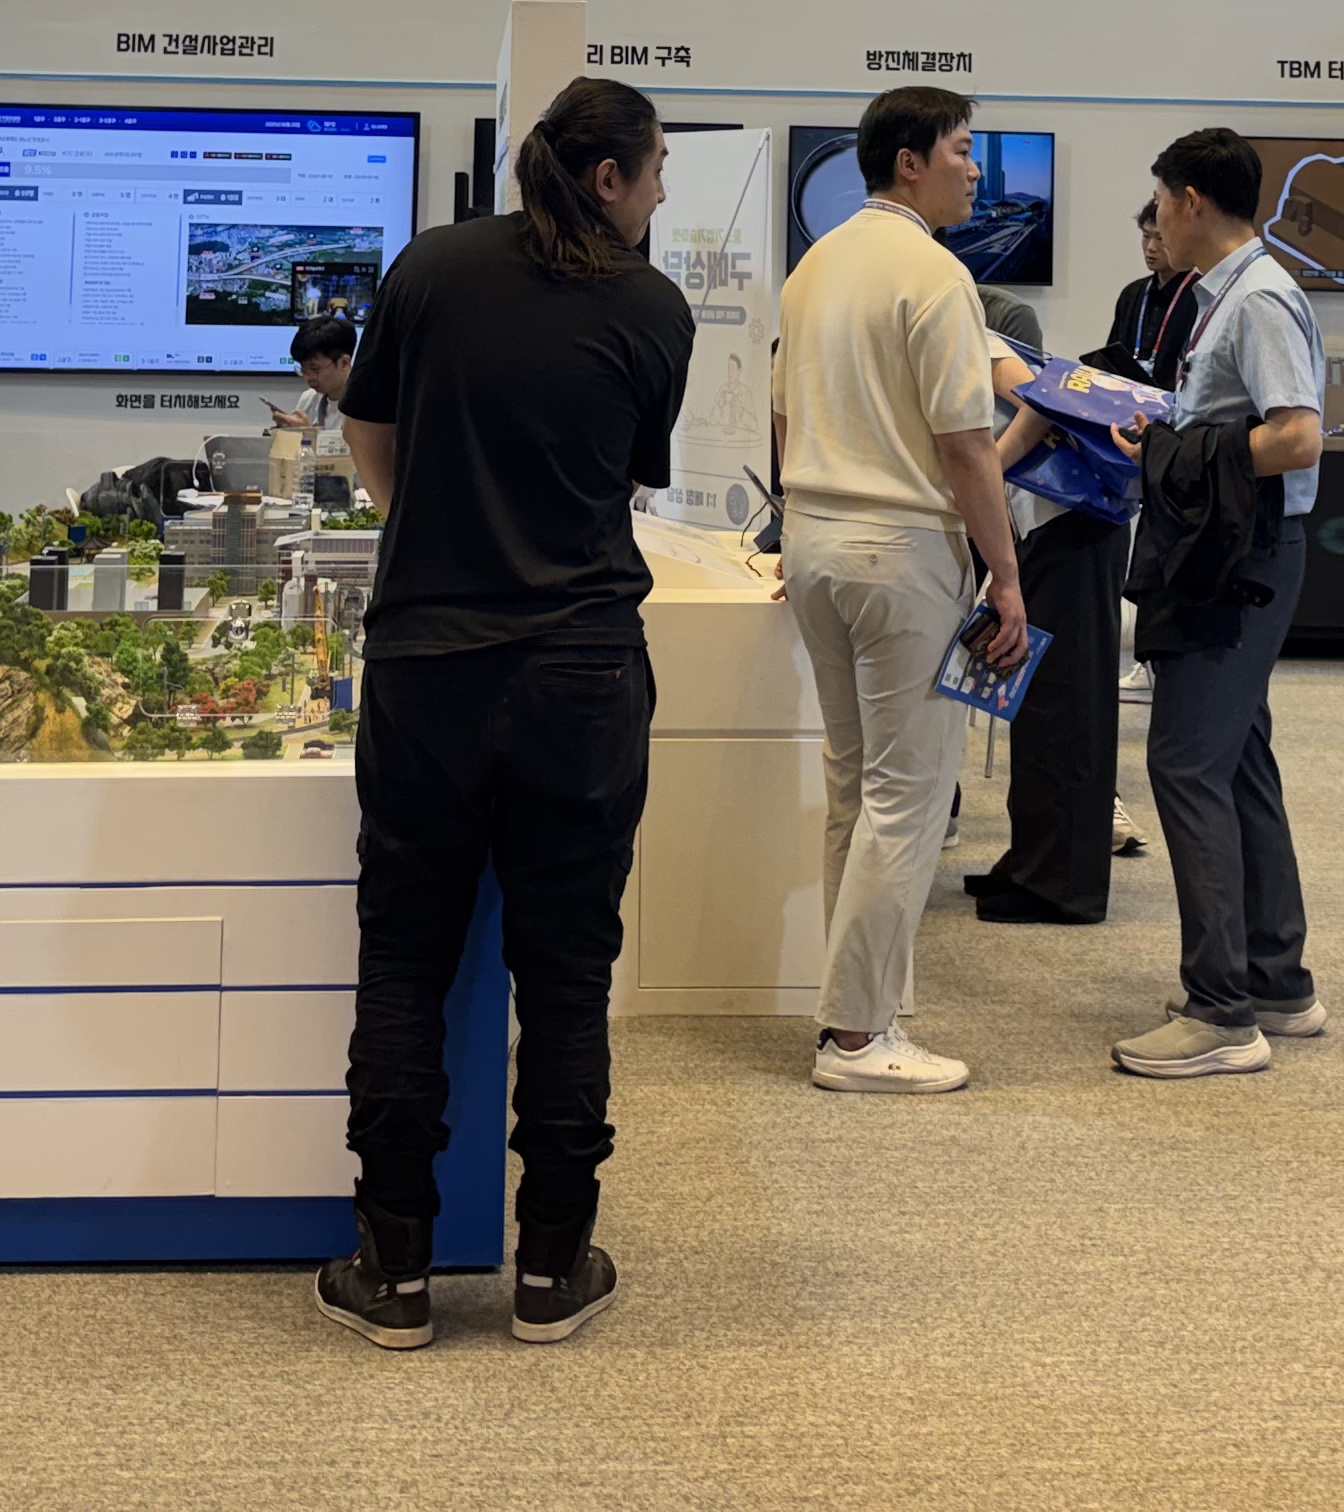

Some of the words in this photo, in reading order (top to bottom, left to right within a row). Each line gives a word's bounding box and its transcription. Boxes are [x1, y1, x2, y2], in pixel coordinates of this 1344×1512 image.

[116, 33, 156, 53] BIM
[162, 33, 275, 57] 건설사업관리
[586, 44, 604, 65] 리
[610, 45, 649, 65] BIM
[654, 45, 692, 68] 구축
[866, 50, 973, 73] 방진체결장치
[1277, 60, 1321, 79] TBM
[116, 393, 156, 409] 화면을
[160, 393, 240, 409] 터치해보세요
